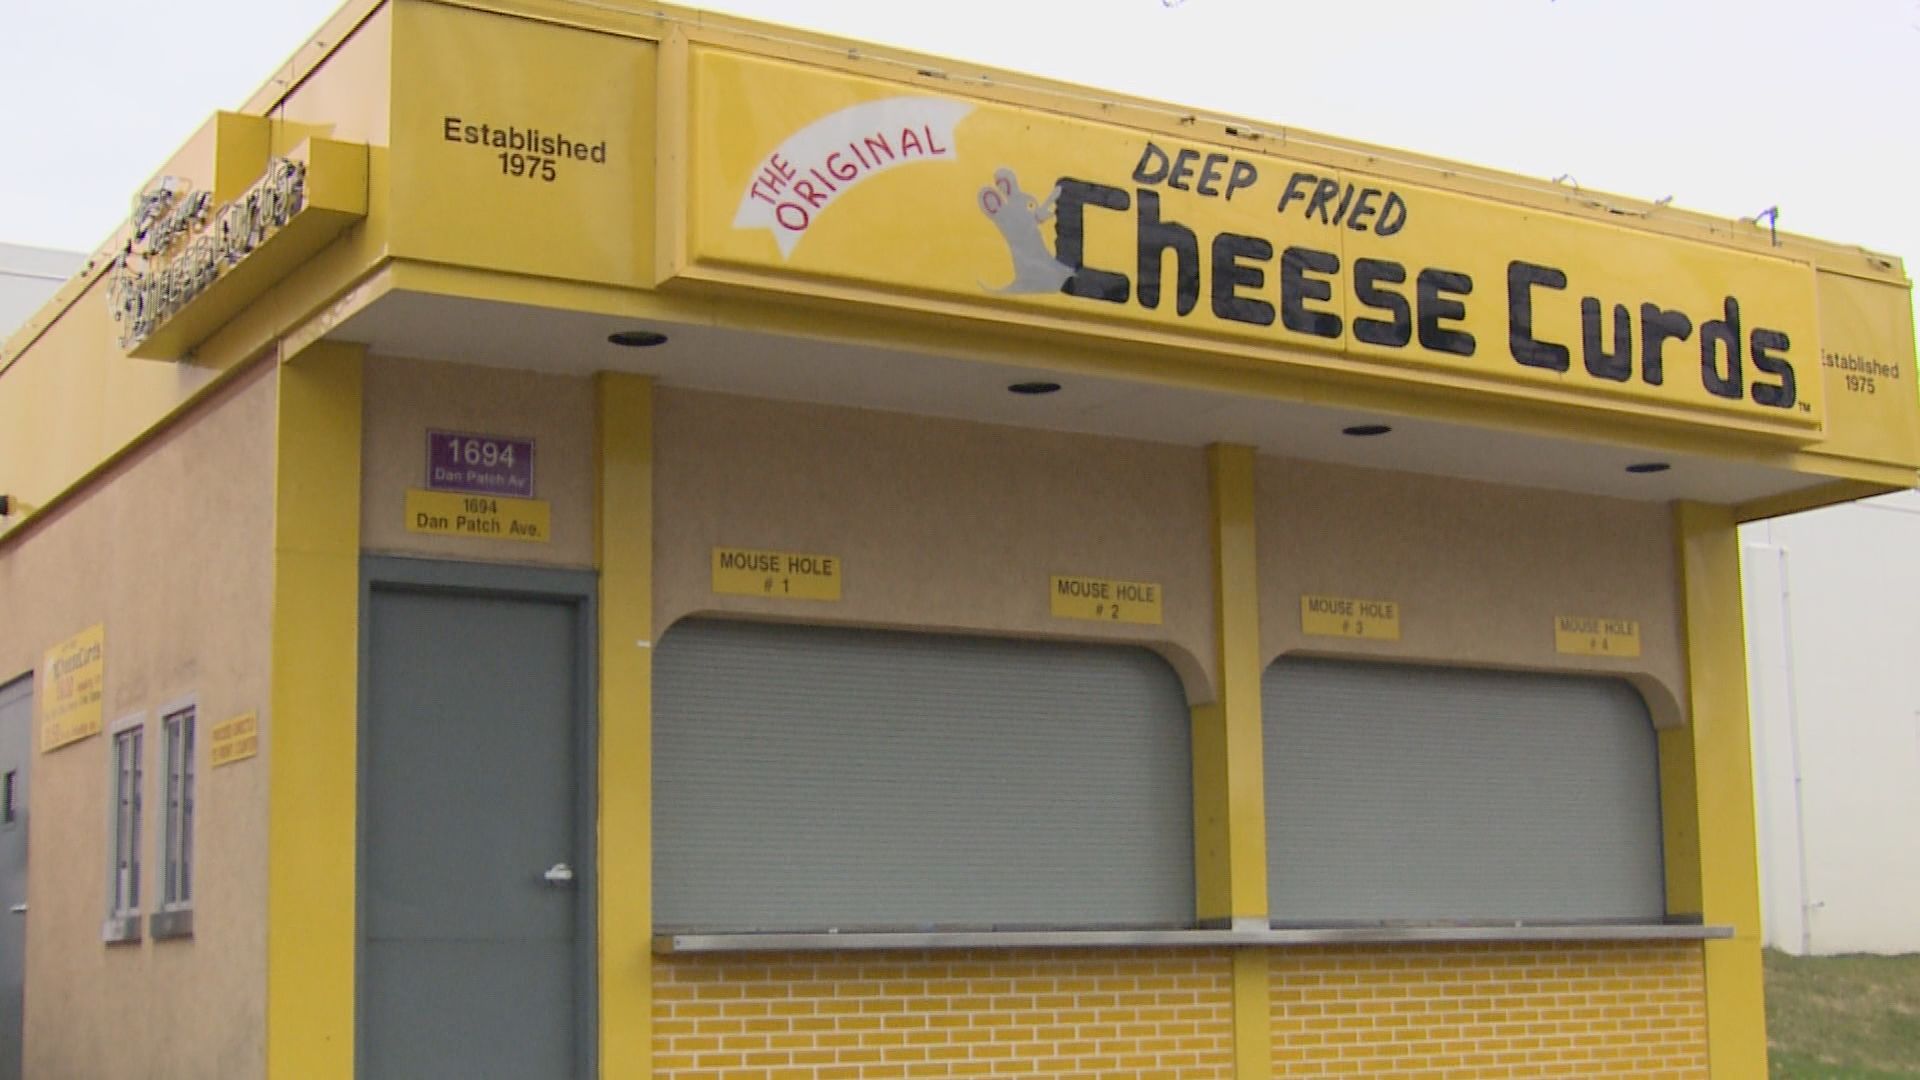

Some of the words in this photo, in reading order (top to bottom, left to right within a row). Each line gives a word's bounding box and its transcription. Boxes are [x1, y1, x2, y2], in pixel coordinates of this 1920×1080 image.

[443, 116, 606, 165] Established
[498, 151, 557, 183] 1975
[750, 152, 797, 205] THE
[775, 124, 946, 232] ORIGINAL
[1132, 141, 1258, 201] DEEP
[1277, 171, 1407, 237] FRIED
[1507, 259, 1797, 409] Curds
[1846, 375, 1875, 395] 1975
[448, 438, 515, 469] 1694
[435, 467, 462, 481] Dan
[467, 470, 505, 486] Patch
[463, 498, 498, 515] 1694
[416, 513, 448, 530] Dan
[456, 516, 501, 534] Patch
[510, 520, 542, 537] Ave.
[720, 551, 781, 573] MOUSE
[788, 556, 833, 576] HOLE
[764, 577, 774, 593] #
[781, 579, 789, 594] 1
[1058, 579, 1110, 600] MOUSE
[1117, 584, 1154, 602] HOLE
[1111, 603, 1120, 620] 2
[1308, 597, 1354, 617] MOUSE
[1360, 601, 1393, 620] HOLE
